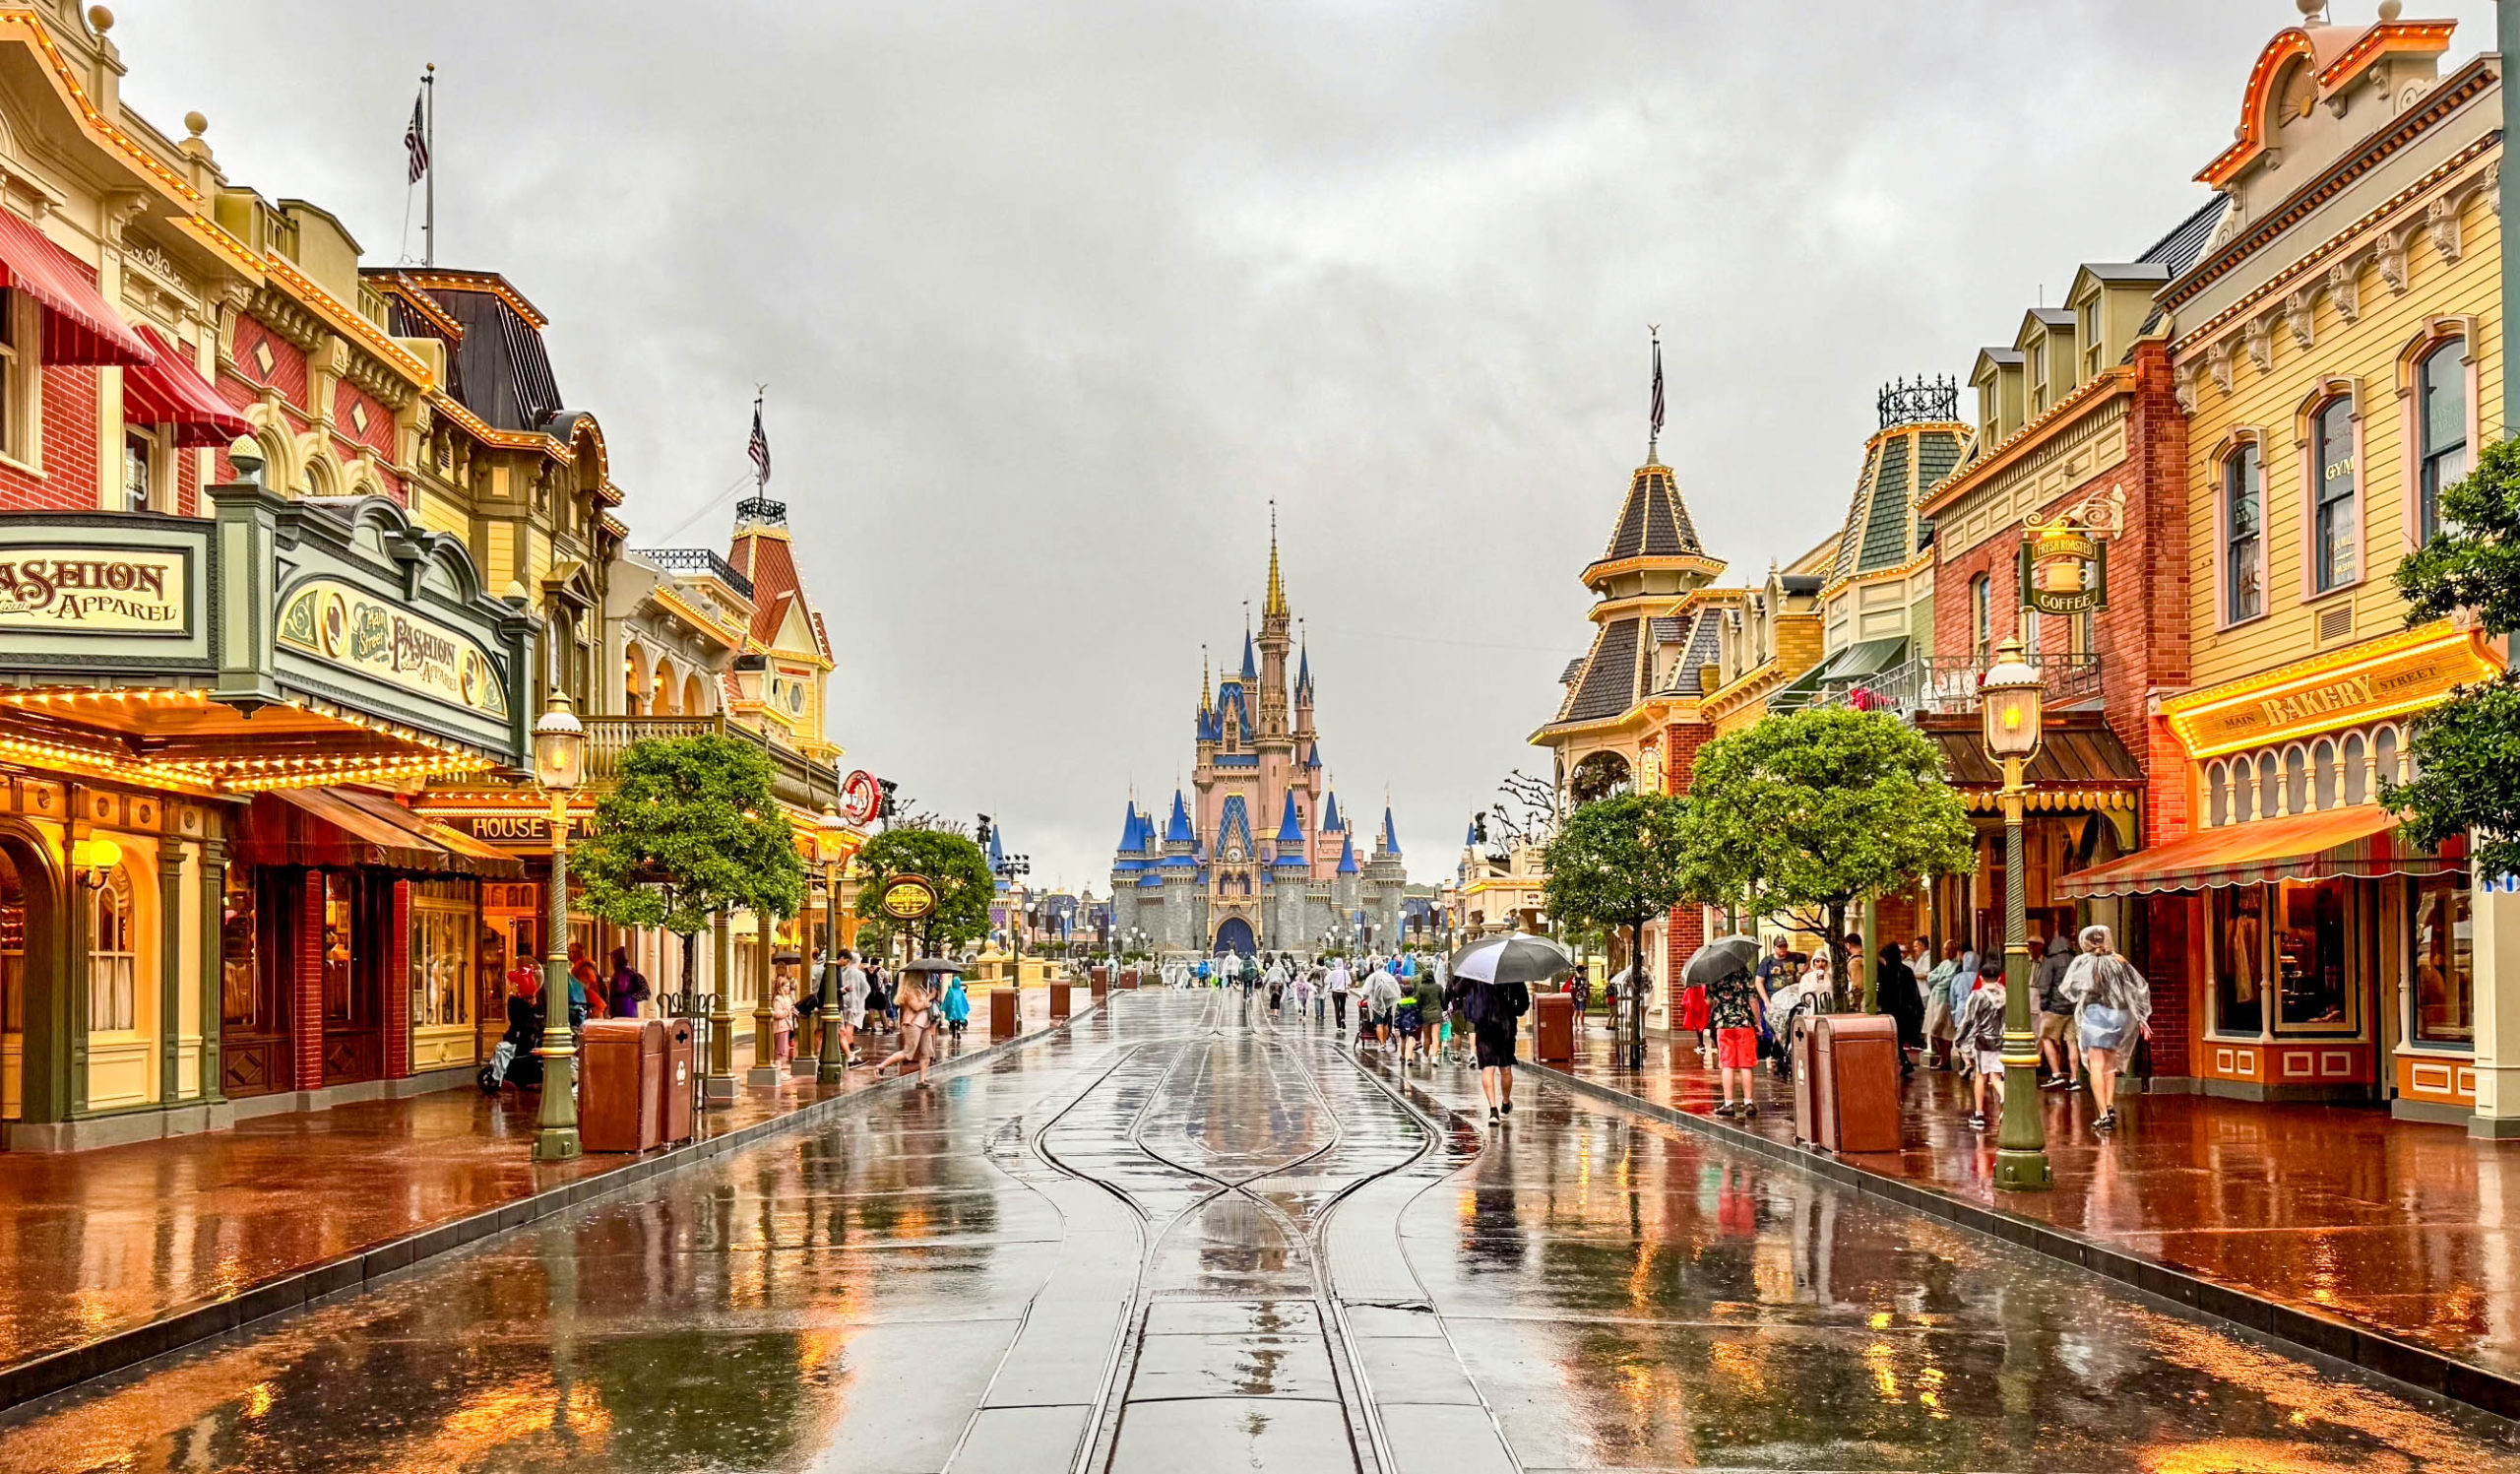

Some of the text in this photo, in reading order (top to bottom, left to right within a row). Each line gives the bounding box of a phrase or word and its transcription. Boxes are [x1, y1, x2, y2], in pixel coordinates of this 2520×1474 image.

[2325, 455, 2356, 481] GYM
[2038, 539, 2093, 556] FRESH ROASTED
[0, 559, 168, 610] ASHION
[47, 594, 177, 621] APPAREL
[2041, 594, 2091, 609] COFFEE
[365, 609, 387, 630] Main
[358, 630, 385, 657] Street
[388, 615, 456, 673] FASHION
[421, 662, 458, 690] APPAREL
[2224, 666, 2437, 728] MAIN BAKERY STREET
[472, 818, 544, 837] HOUSE
